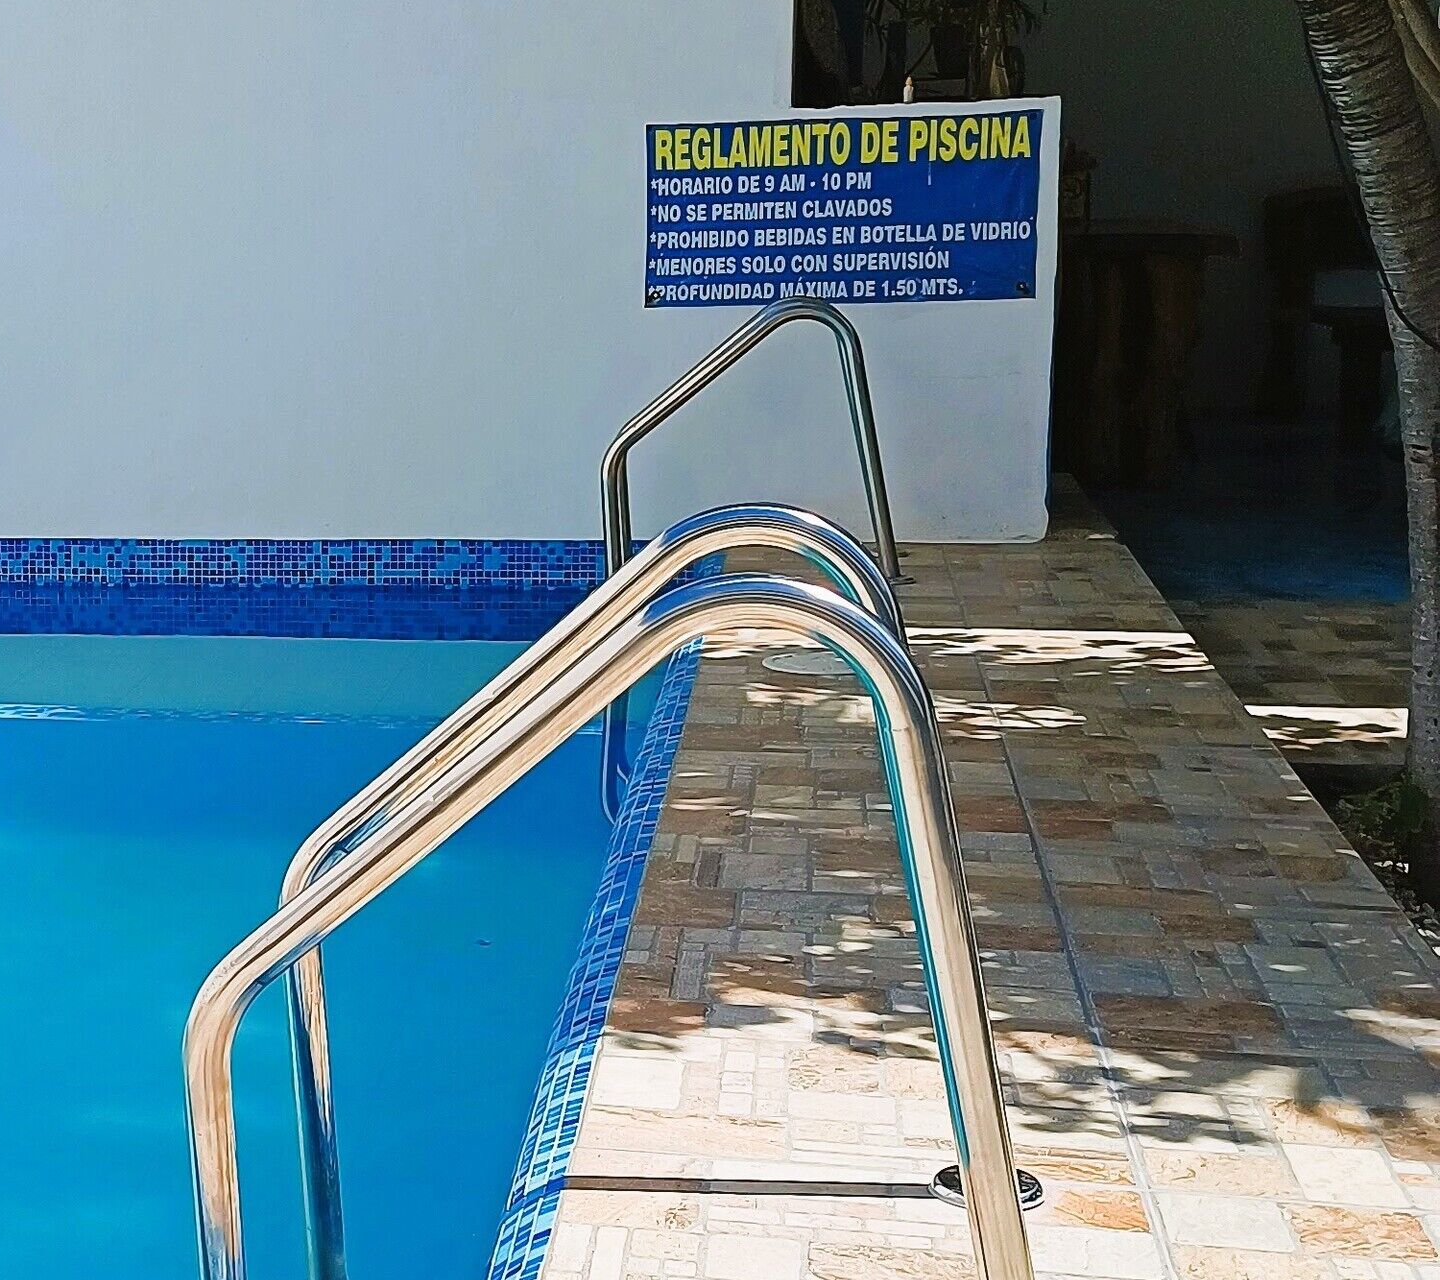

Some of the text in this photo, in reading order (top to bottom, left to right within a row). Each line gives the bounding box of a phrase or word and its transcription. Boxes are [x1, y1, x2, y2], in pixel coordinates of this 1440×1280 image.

[655, 116, 1031, 170] REGLAMENTO DE PISCINA
[738, 176, 760, 194] DE
[765, 175, 774, 192] 9
[779, 174, 805, 192] AM
[822, 173, 841, 191] 10
[846, 172, 872, 190] PM
[686, 204, 707, 221] SE
[712, 201, 797, 221] PERMITEN
[802, 198, 892, 219] CLAVADOS
[754, 228, 827, 247] BEBIDAS
[832, 226, 855, 245] EN
[860, 223, 937, 244] BOTELLA
[942, 223, 965, 242] DE
[971, 220, 1031, 241] VIDRIO
[741, 256, 787, 274] SOLO
[791, 255, 827, 272] CON
[832, 246, 950, 271] SUPERVISIÓN
[780, 277, 847, 299] MÁXIMA
[853, 280, 876, 297] DE
[881, 278, 917, 297] 1.50
[920, 278, 964, 296] MTS.
